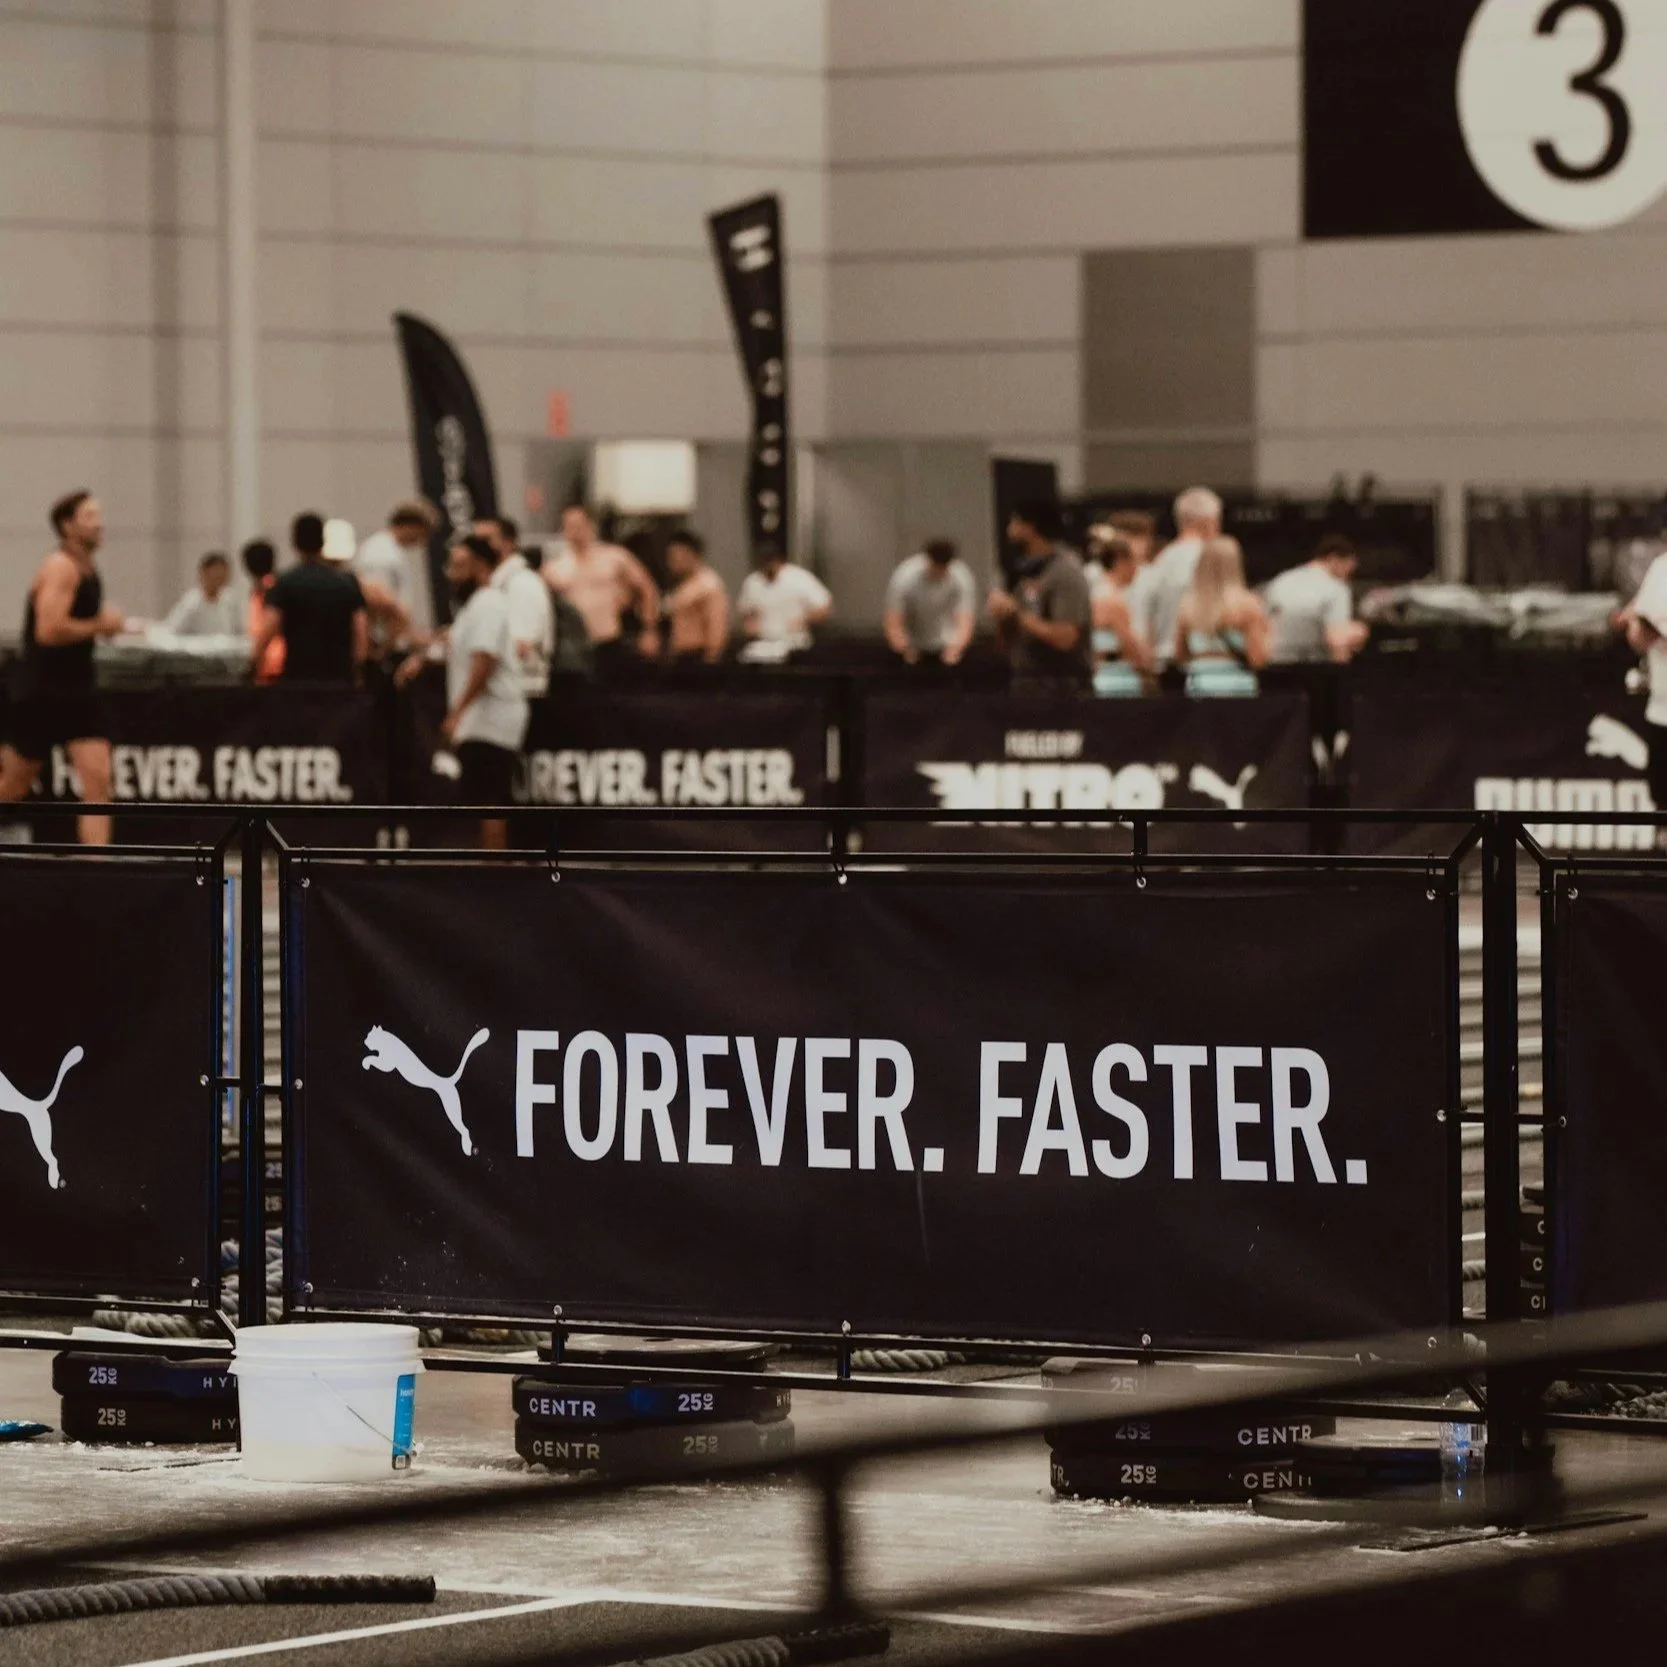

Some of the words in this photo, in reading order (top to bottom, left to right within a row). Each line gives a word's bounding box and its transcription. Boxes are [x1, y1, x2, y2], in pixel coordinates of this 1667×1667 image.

[1533, 0, 1632, 182] 3
[214, 746, 352, 800] FASTER.
[514, 750, 657, 804] REVER.
[661, 750, 804, 805] FASTER.
[515, 1029, 945, 1172] FOREVER.
[977, 1041, 1368, 1185] FASTER.
[529, 1397, 596, 1417] CENTR
[532, 1440, 600, 1460] CENTR
[1237, 1424, 1312, 1445] CENTR
